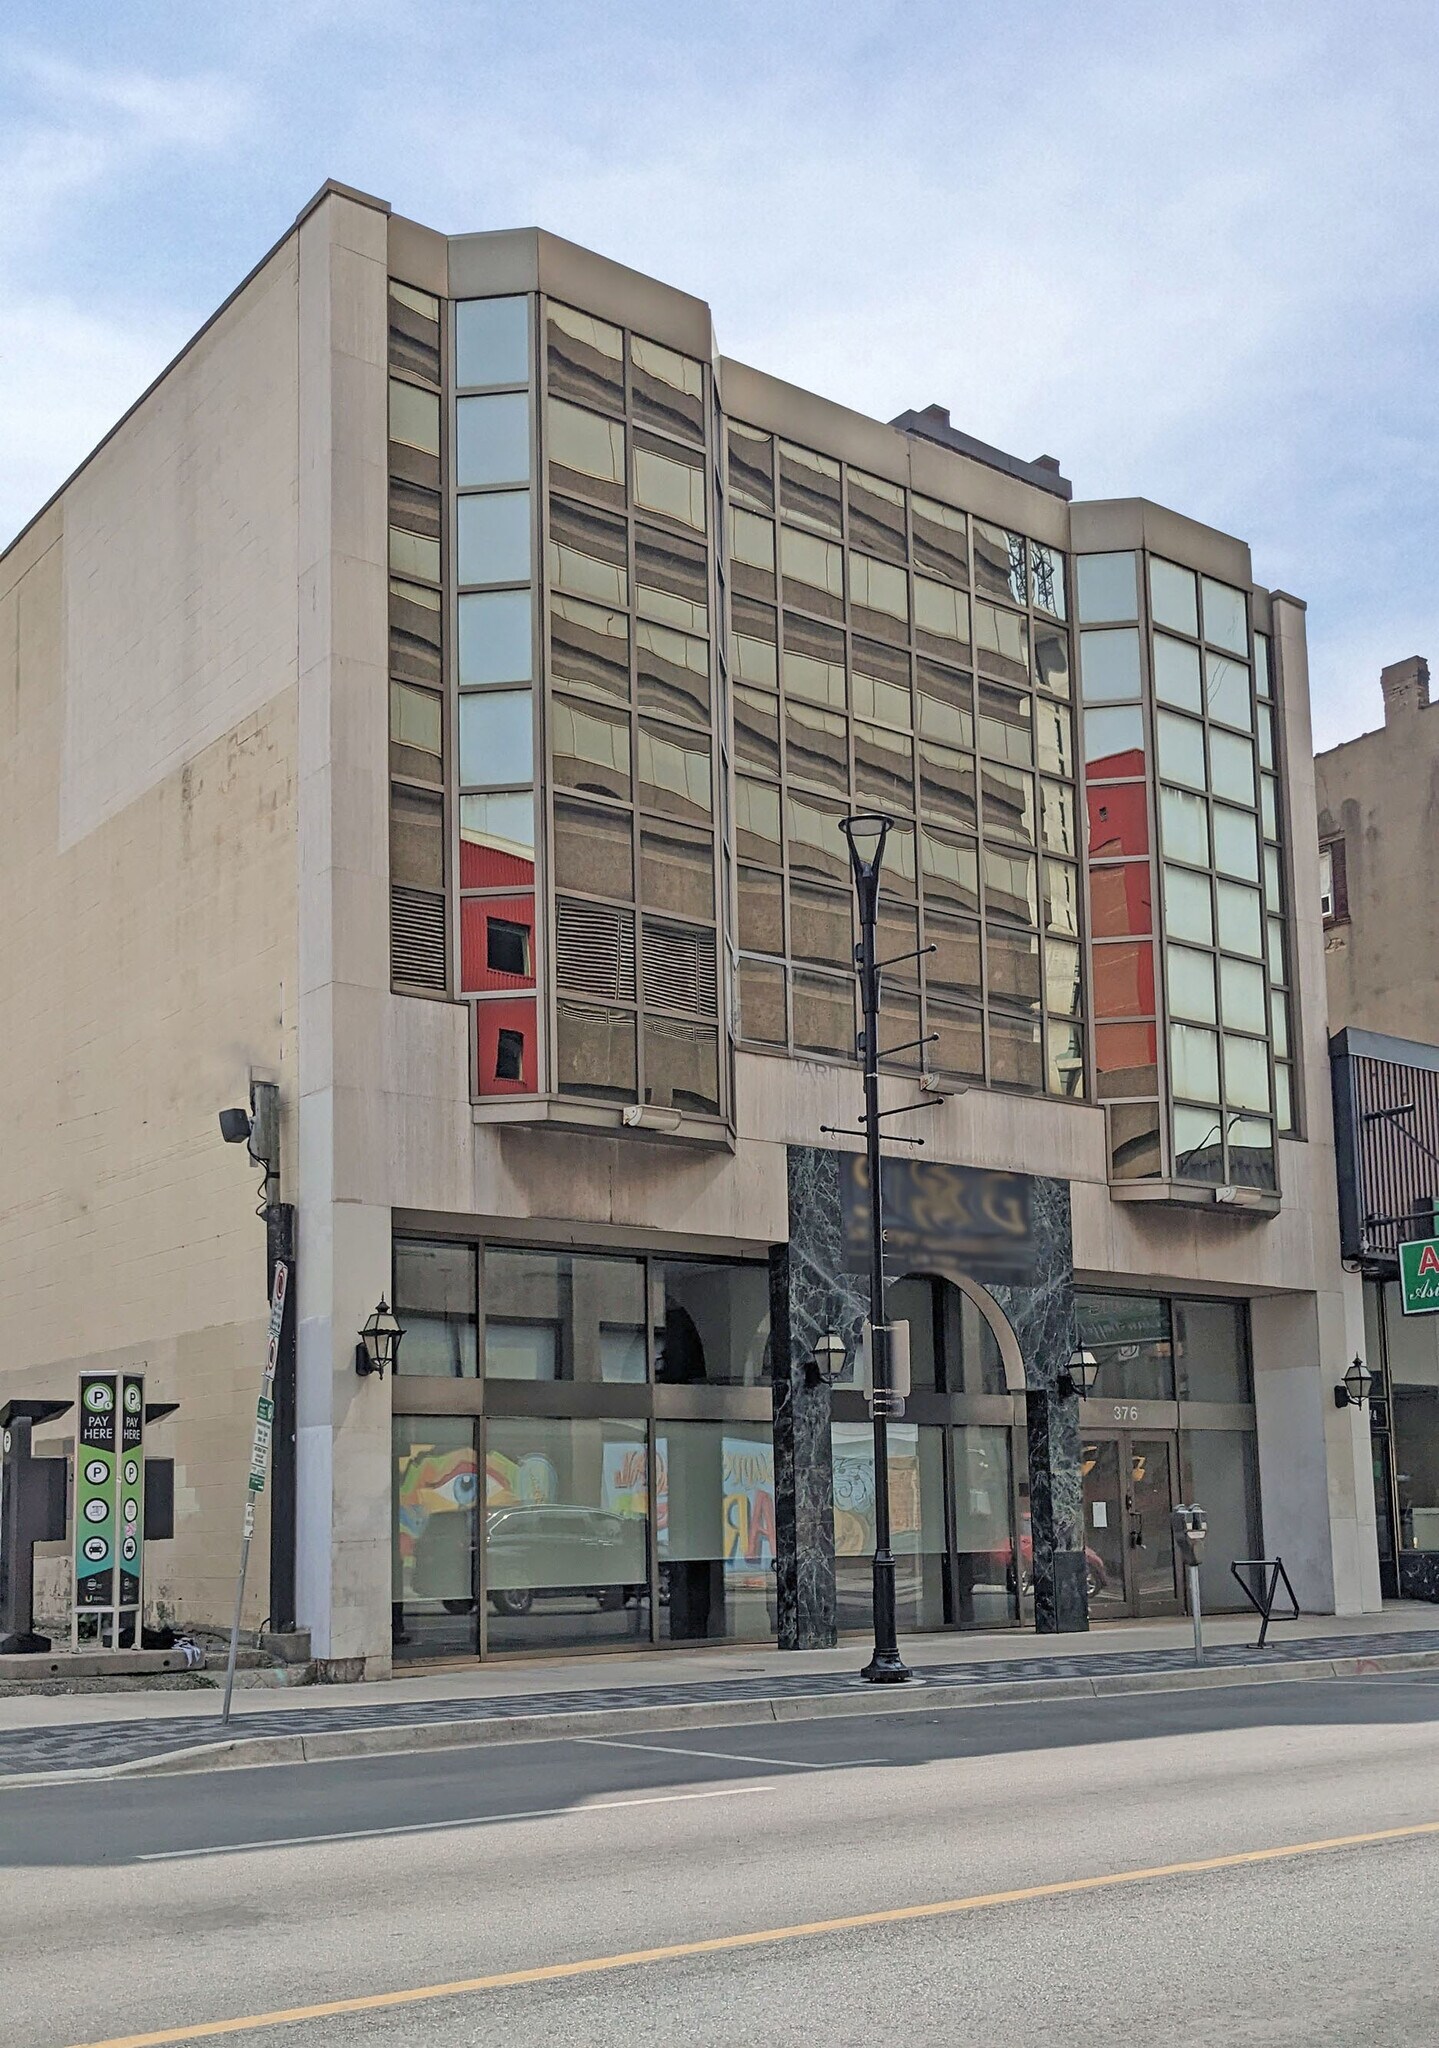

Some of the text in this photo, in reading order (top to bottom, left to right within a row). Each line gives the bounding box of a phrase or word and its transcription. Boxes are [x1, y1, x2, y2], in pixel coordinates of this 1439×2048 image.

[94, 1391, 104, 1404] P
[1113, 1405, 1138, 1421] 376
[88, 1416, 110, 1427] PAY
[126, 1416, 139, 1428] PAY
[84, 1428, 113, 1439] HERE
[123, 1428, 141, 1440] HERE
[93, 1467, 102, 1478] P
